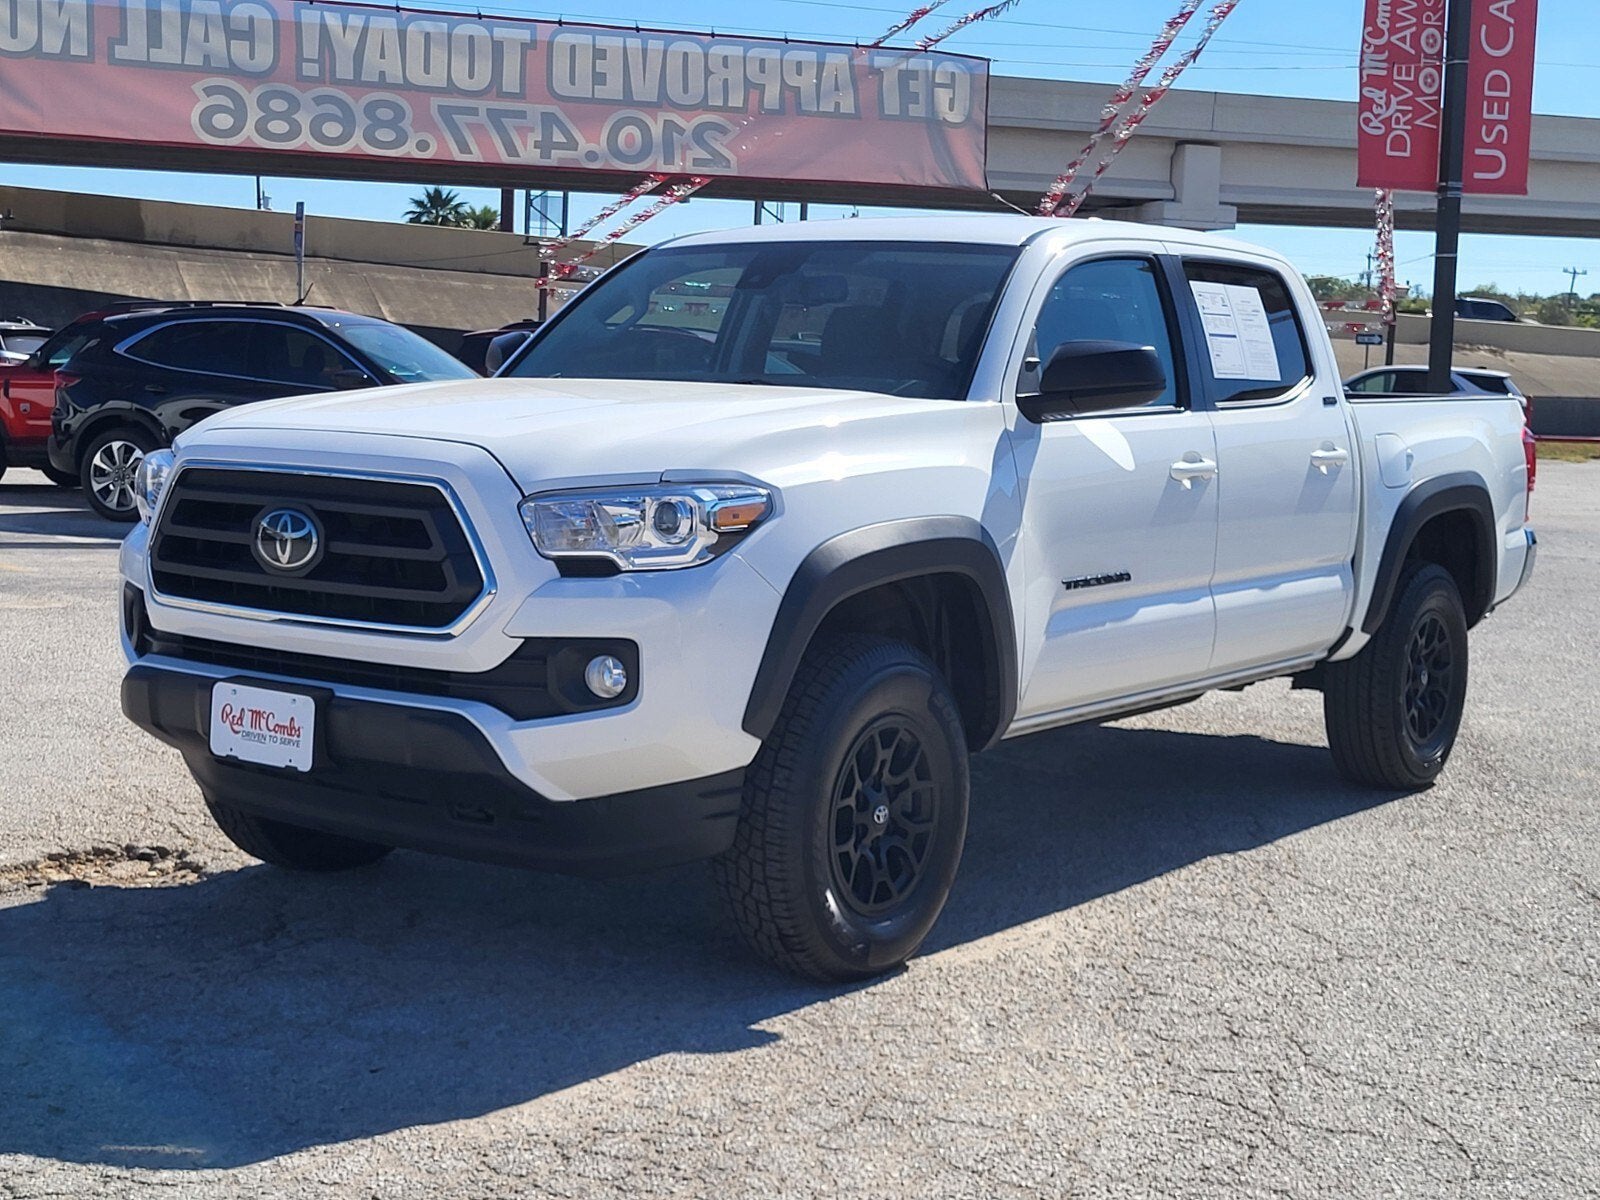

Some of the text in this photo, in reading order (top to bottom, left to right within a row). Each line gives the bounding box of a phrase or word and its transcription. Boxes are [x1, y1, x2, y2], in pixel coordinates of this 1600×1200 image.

[1386, 0, 1418, 158] DRIVE AW
[1473, 0, 1516, 180] USED CA
[1360, 87, 1398, 136] Red
[221, 703, 302, 738] Red McCombs
[241, 730, 301, 748] DRIVEN TO SERVE
